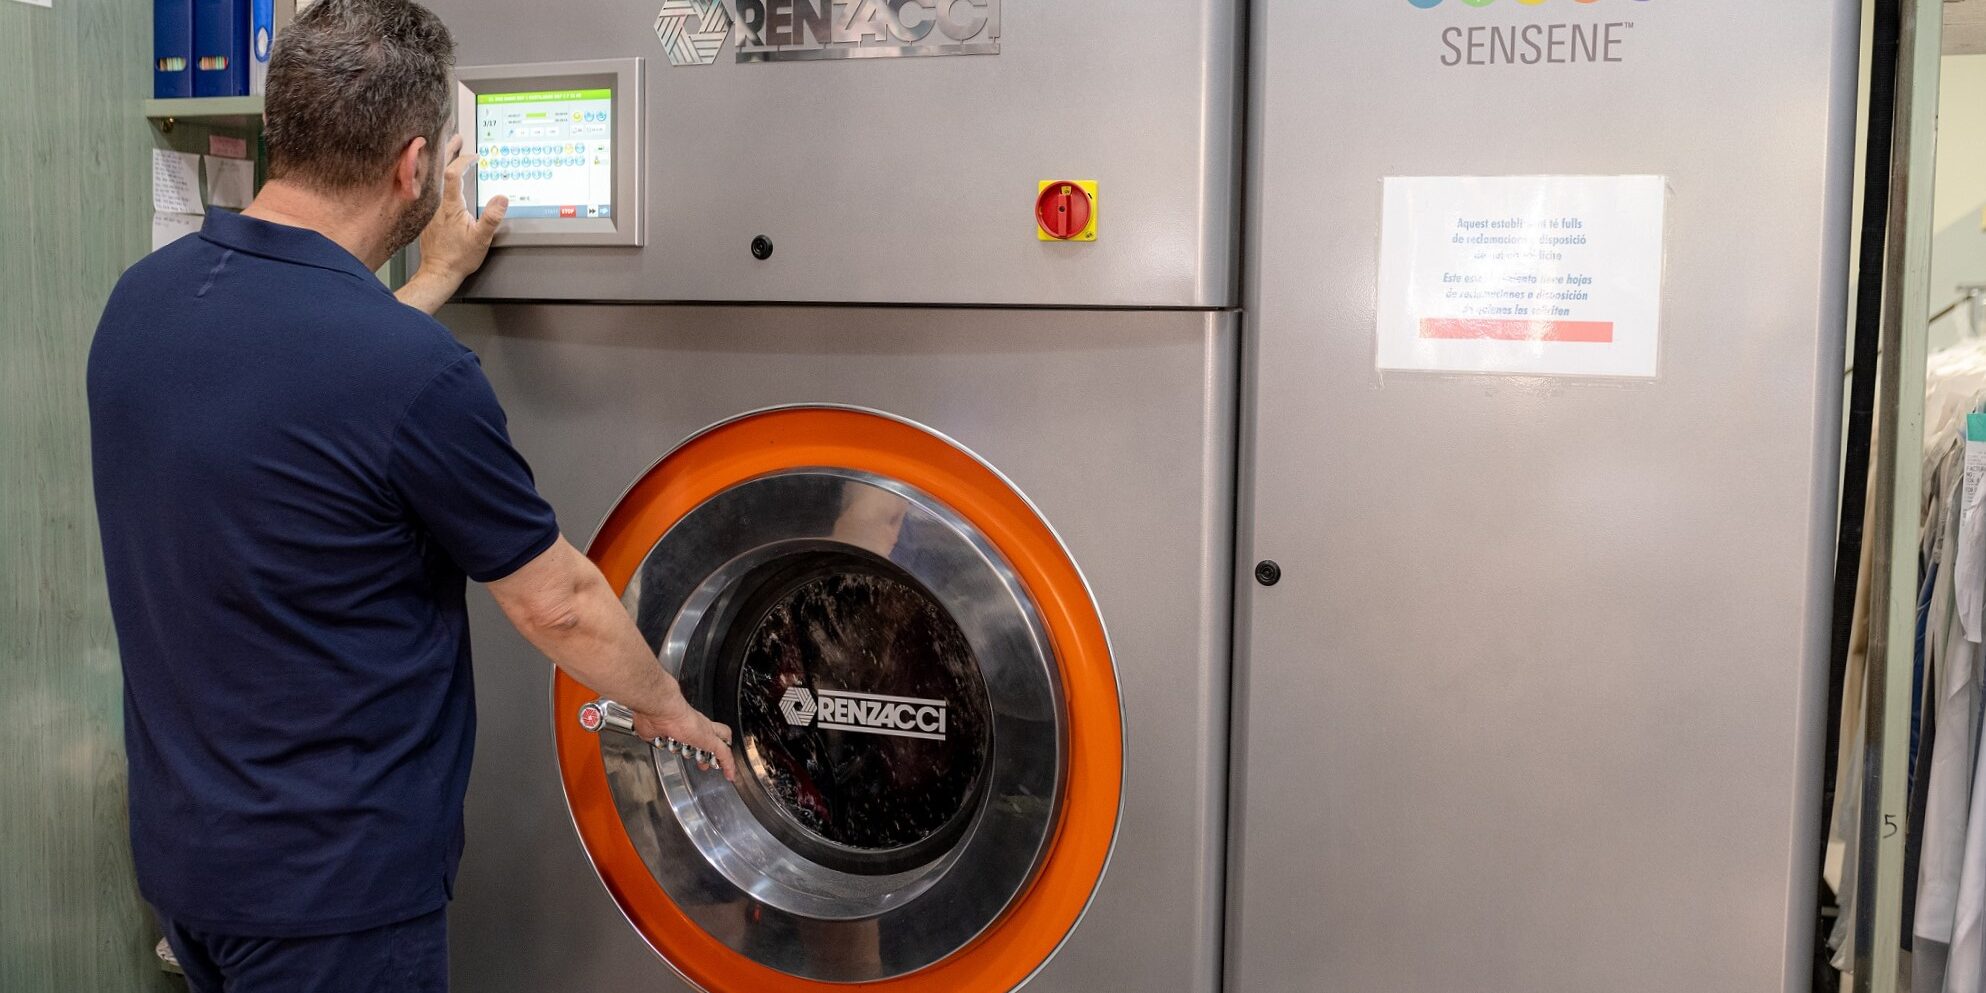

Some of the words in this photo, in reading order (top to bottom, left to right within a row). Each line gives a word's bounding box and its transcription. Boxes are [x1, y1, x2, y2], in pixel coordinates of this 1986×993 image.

[735, 0, 1000, 46] RENZACCI
[1457, 218, 1488, 230] Aquest
[1562, 217, 1583, 229] fulls
[1452, 233, 1464, 243] de
[1443, 272, 1462, 283] Este
[1566, 273, 1592, 286] hojas
[1514, 304, 1528, 315] las
[817, 696, 946, 733] RENZACCI
[1883, 814, 1898, 839] 5
